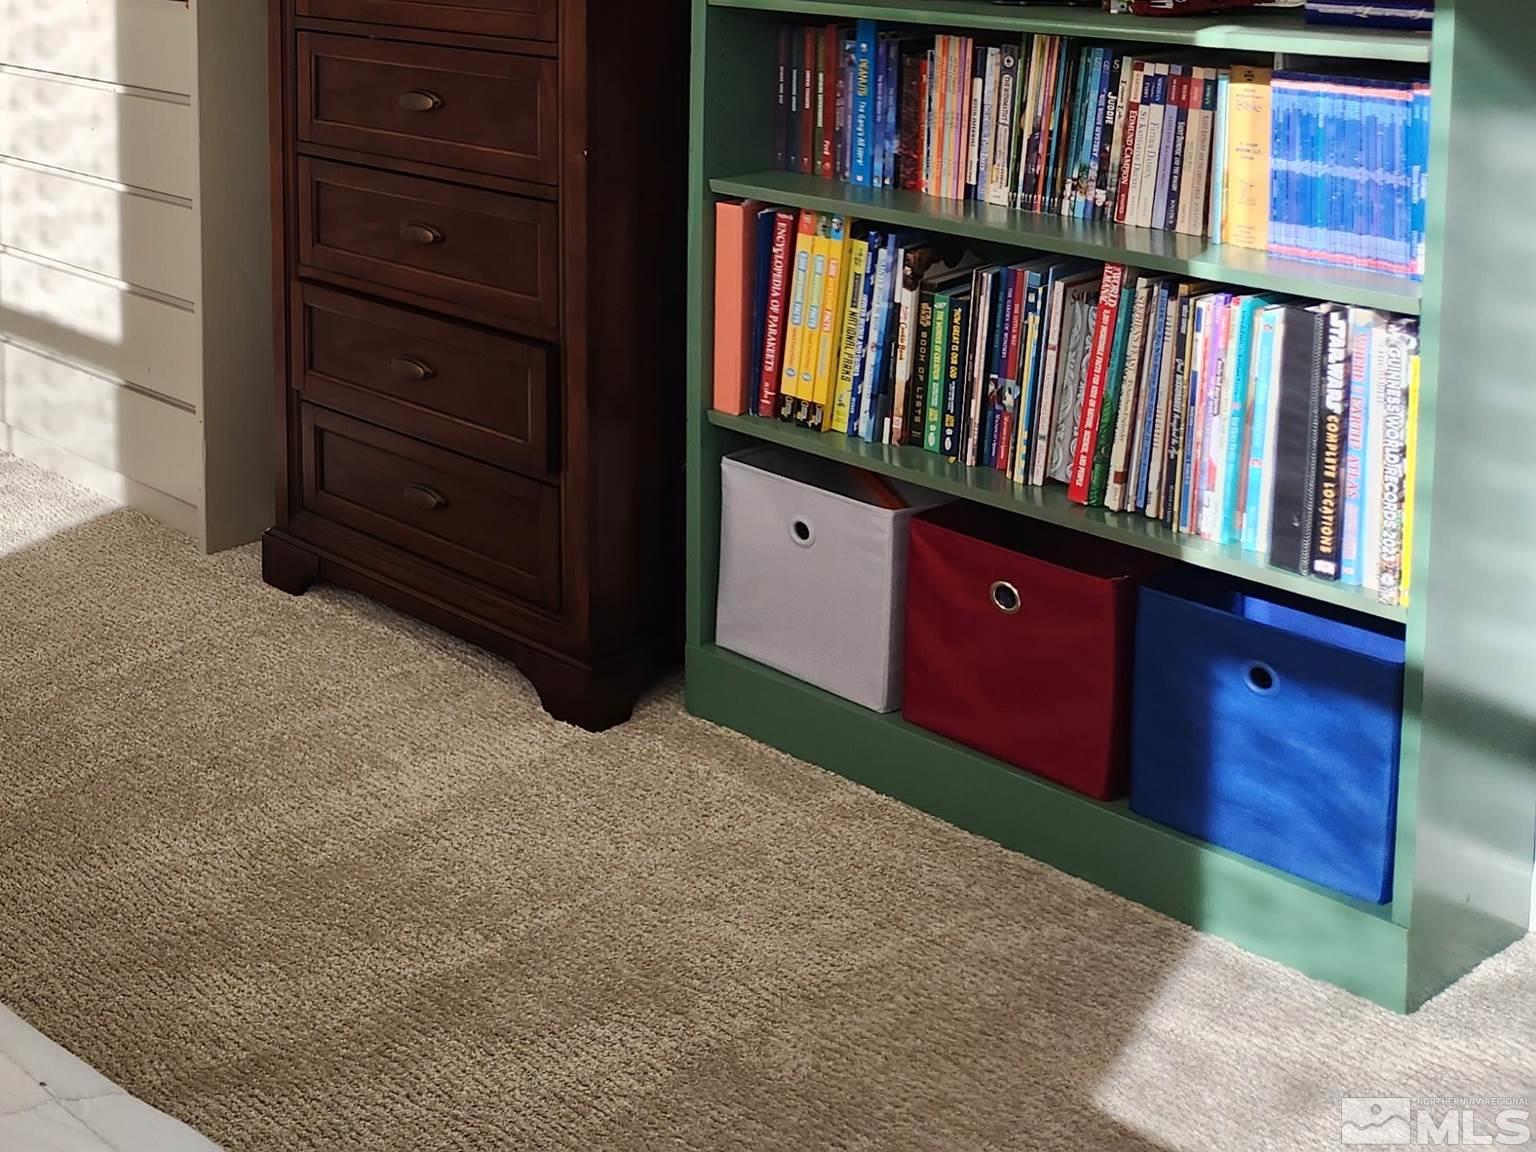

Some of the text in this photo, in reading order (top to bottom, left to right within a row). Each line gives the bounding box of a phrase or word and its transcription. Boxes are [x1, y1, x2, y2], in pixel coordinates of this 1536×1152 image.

[856, 58, 868, 96] PEANUTS
[1105, 91, 1116, 124] JUDDIE
[1091, 126, 1100, 156] MYSTERY
[1176, 120, 1185, 135] SAINT
[1121, 110, 1137, 184] EDMUND CAMPION
[770, 222, 787, 297] ENCYCLOPEDIA
[1099, 263, 1113, 305] ALMANAC
[1108, 271, 1121, 307] WORLD
[769, 299, 781, 313] OF
[935, 310, 943, 320] THE
[765, 314, 780, 372] PARAKEETS
[845, 310, 857, 349] NATIONAL
[898, 322, 907, 343] Cookie
[951, 325, 960, 344] GREAT
[841, 351, 853, 382] PARKS
[949, 365, 957, 378] GOD
[950, 351, 958, 364] OUR
[1093, 356, 1103, 373] FACTS
[1353, 334, 1367, 380] WHERE
[914, 331, 927, 422] BOOK OF LISTS
[1091, 373, 1100, 385] FOR
[1318, 311, 1348, 553] STAR WARS COMPLETE LOCATIONS
[1078, 454, 1087, 466] AND
[1380, 346, 1403, 562] GUINNESS WORLD RECORDS 2023
[1075, 466, 1085, 486] PEOPLE
[1347, 454, 1361, 498] ATLAS
